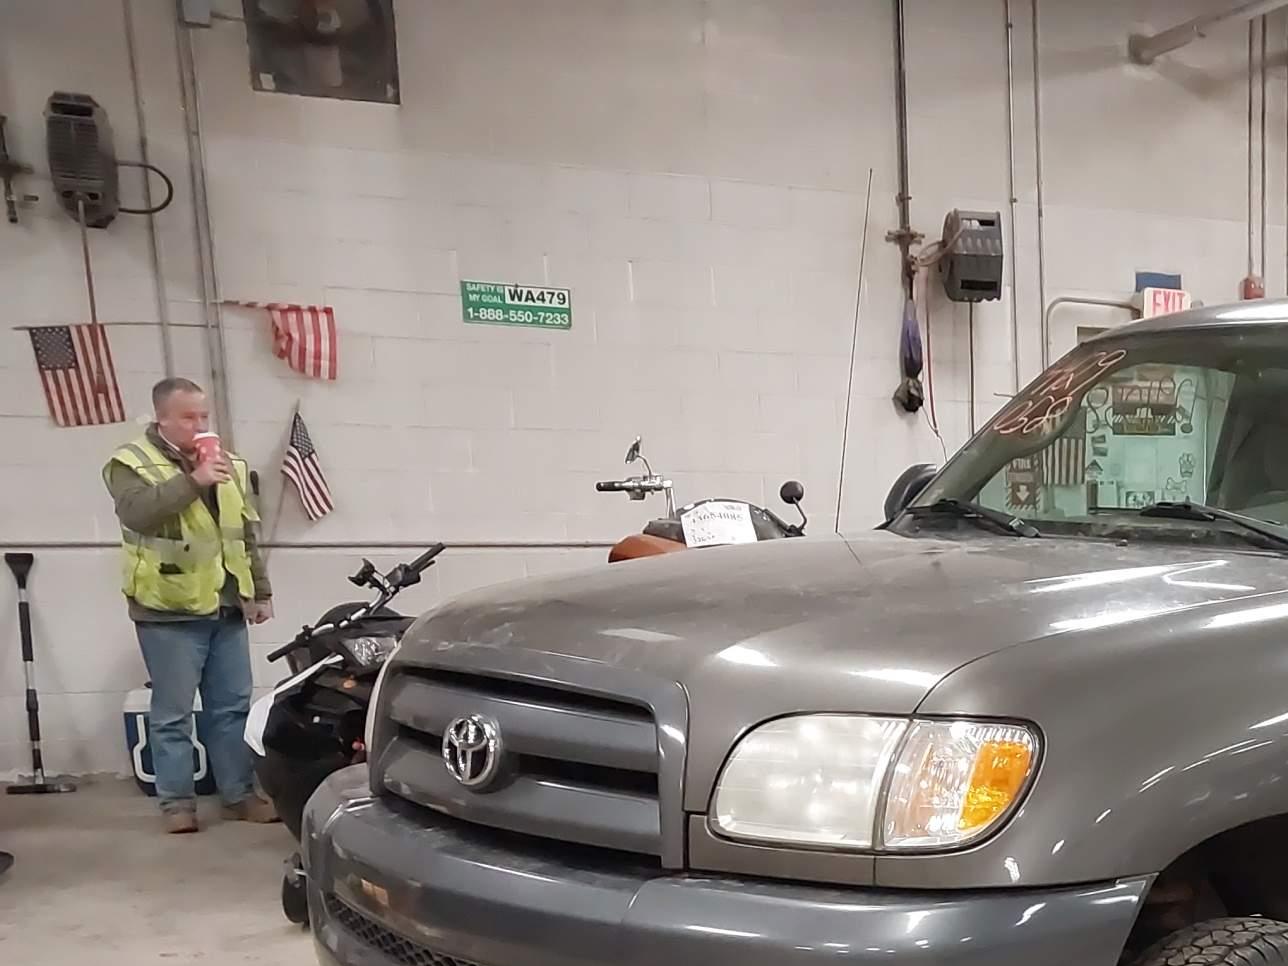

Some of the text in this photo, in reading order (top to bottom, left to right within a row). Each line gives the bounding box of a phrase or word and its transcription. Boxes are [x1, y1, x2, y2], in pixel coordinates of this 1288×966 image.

[466, 283, 496, 292] SAFETY
[468, 293, 503, 303] MY GOAL
[508, 288, 566, 305] WA479
[1152, 290, 1185, 316] EXIT
[467, 307, 569, 325] 1-888-550-7233
